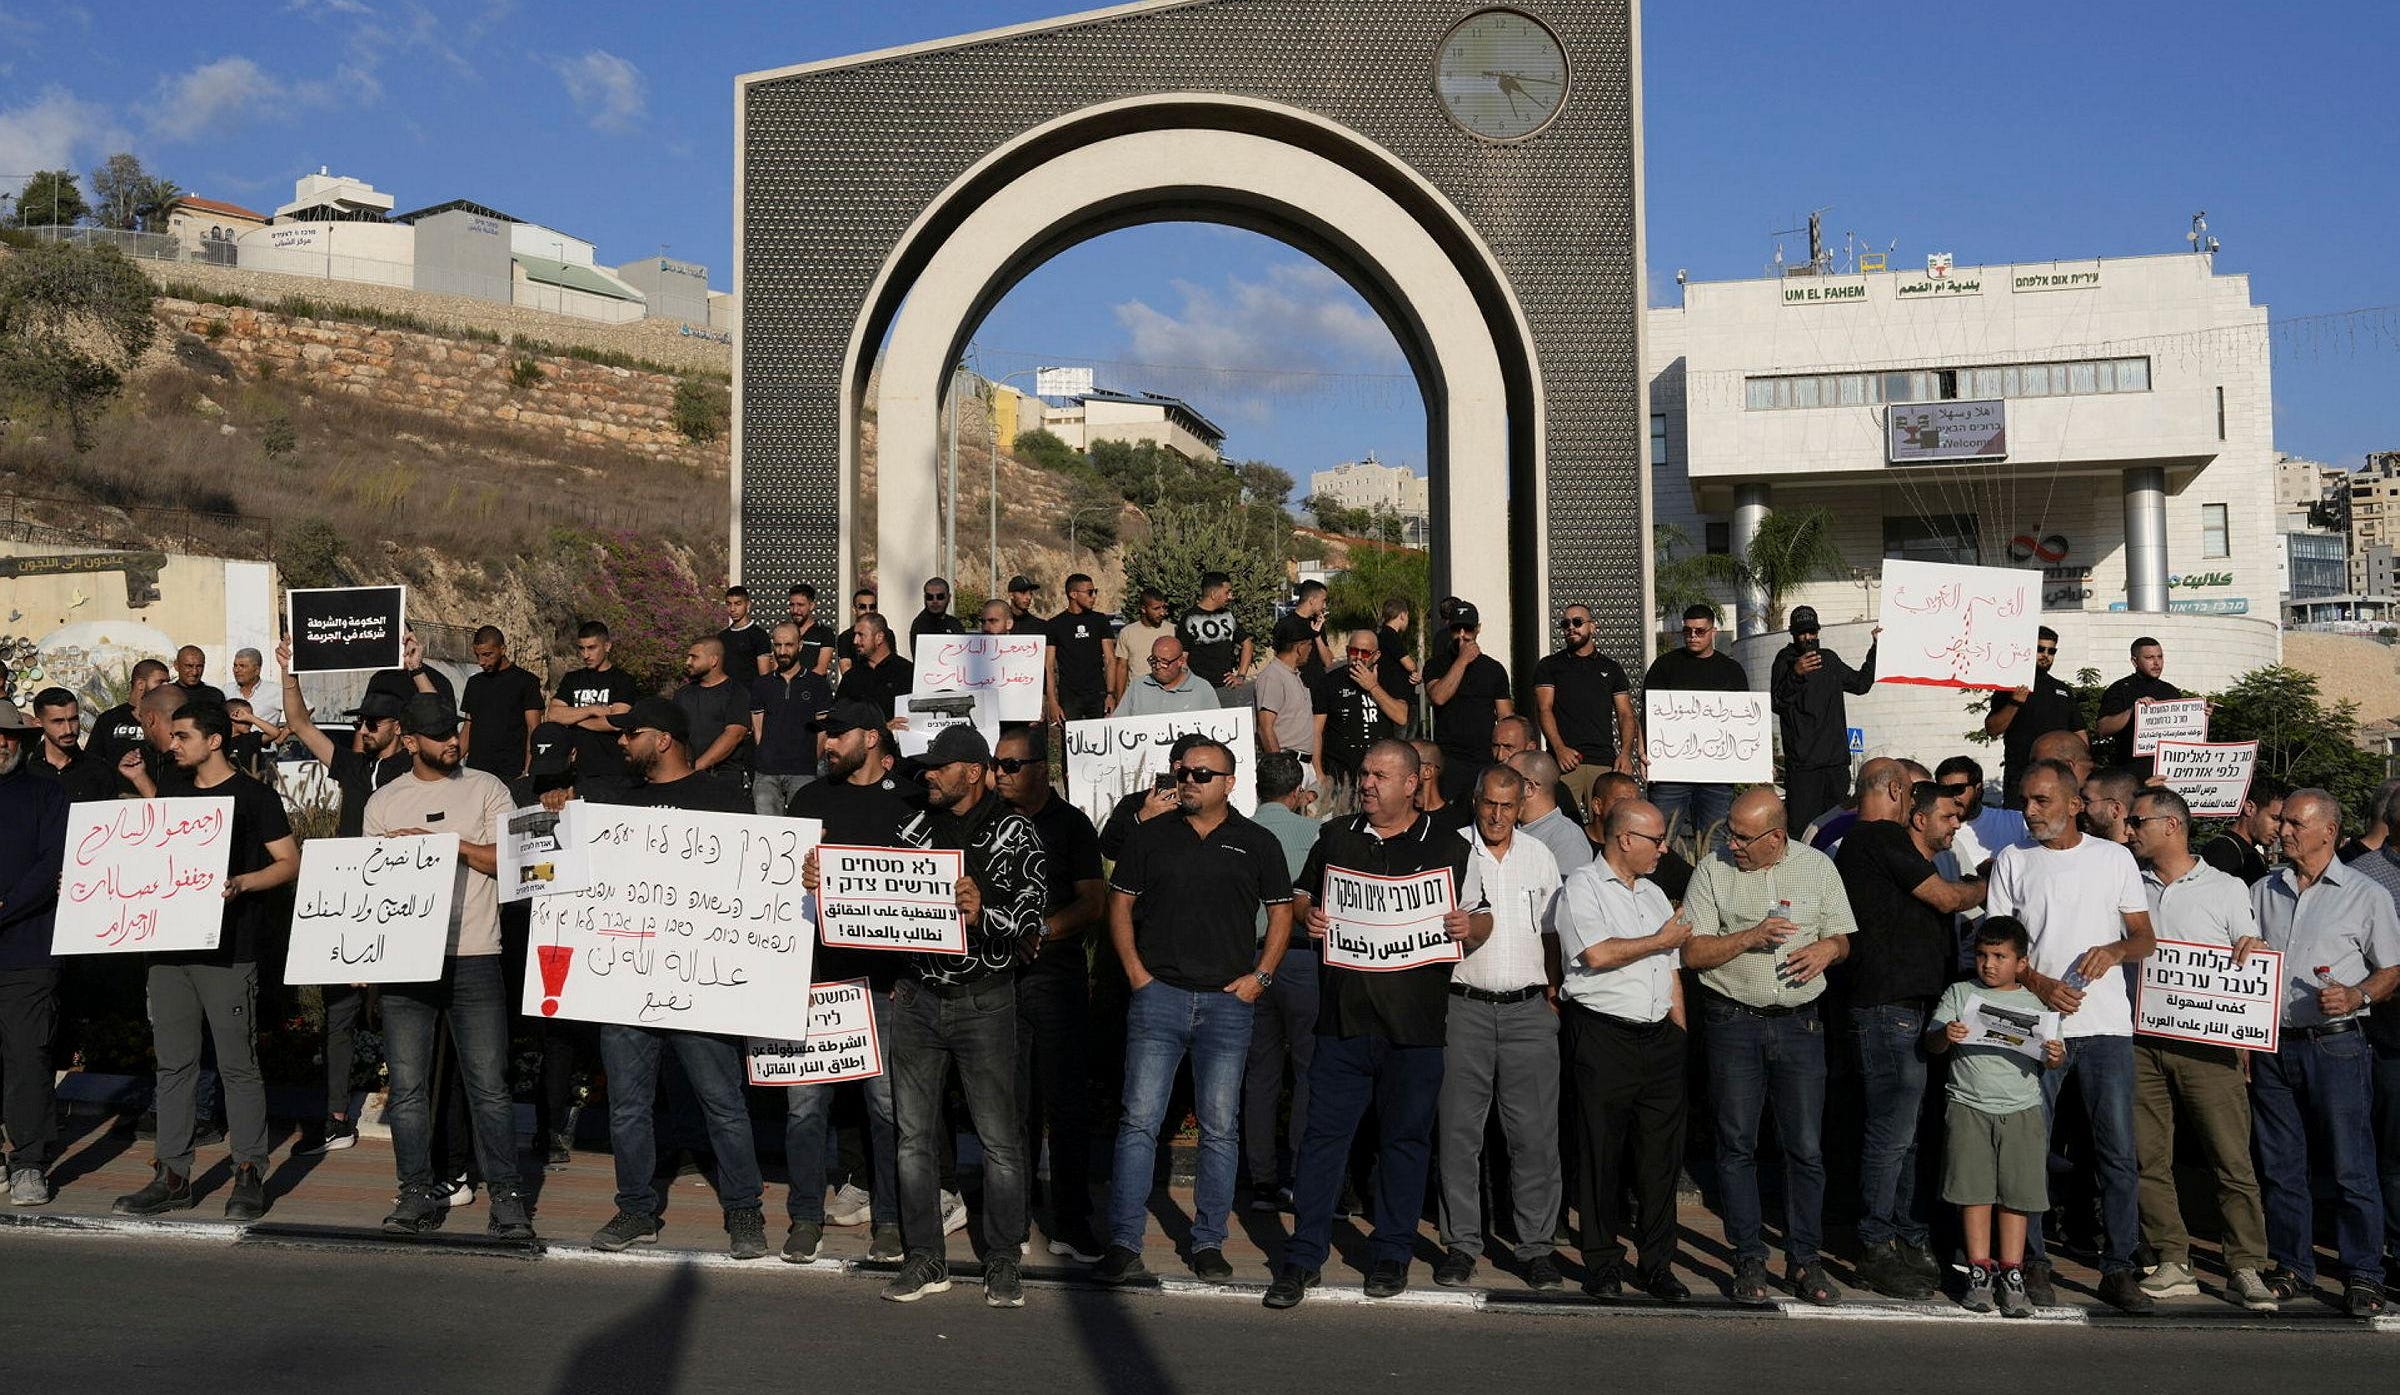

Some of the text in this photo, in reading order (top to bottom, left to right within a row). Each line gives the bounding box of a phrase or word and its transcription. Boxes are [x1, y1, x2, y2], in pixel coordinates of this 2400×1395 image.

[1948, 280, 1980, 293] بلدية
[2015, 273, 2049, 288] אלפחם
[2052, 274, 2067, 285] אום
[1785, 286, 1865, 300] UM EL FAHEM
[1899, 282, 1932, 296] الفحم
[1969, 423, 2000, 431] ברוכים
[2182, 572, 2233, 589] כללית
[2213, 601, 2245, 612] מרכז
[307, 615, 387, 629] الحكومة والشرطة
[307, 627, 386, 644] شركاء في الجريمة
[1702, 696, 1761, 725] الشرطة
[1119, 729, 1147, 749] من
[1211, 717, 1238, 744] لن
[1067, 725, 1112, 756] العدالة
[2163, 747, 2212, 763] לאלימות
[2215, 751, 2226, 762] די
[2173, 767, 2214, 778] אזרחים
[2216, 764, 2240, 778] כלפי
[76, 801, 223, 866] اجمعوا السلاح
[647, 823, 668, 854] לא
[362, 841, 410, 886] نصرخ
[736, 829, 798, 890] צדק
[842, 857, 937, 875] לא מטחים
[71, 864, 160, 902] عصابات
[839, 877, 877, 893] צדק
[885, 878, 951, 895] דורשים
[1423, 878, 1443, 906] דם
[1334, 877, 1362, 913] הפקר
[1365, 883, 1387, 912] אינו
[1389, 883, 1421, 912] ערבי
[351, 893, 372, 923] ولا
[419, 892, 436, 918] لا
[750, 893, 792, 923] את
[825, 903, 957, 921] لا للتغطية على الحقائق
[904, 928, 942, 943] نطالب
[1418, 930, 1452, 949] دمنا
[1378, 934, 1414, 960] ليس
[665, 949, 748, 986] عدالة
[2252, 959, 2269, 974] די
[2157, 968, 2210, 989] ערבים
[2218, 976, 2268, 996] לעבר
[2166, 994, 2246, 1014] كفى لسهولة
[2177, 1019, 2200, 1031] على
[2203, 1022, 2228, 1035] النار
[2231, 1026, 2269, 1044] إطلاق
[752, 1035, 867, 1058] الشرطة مسؤولة عن
[800, 1061, 824, 1076] النار
[827, 1055, 866, 1074] إطلاق
